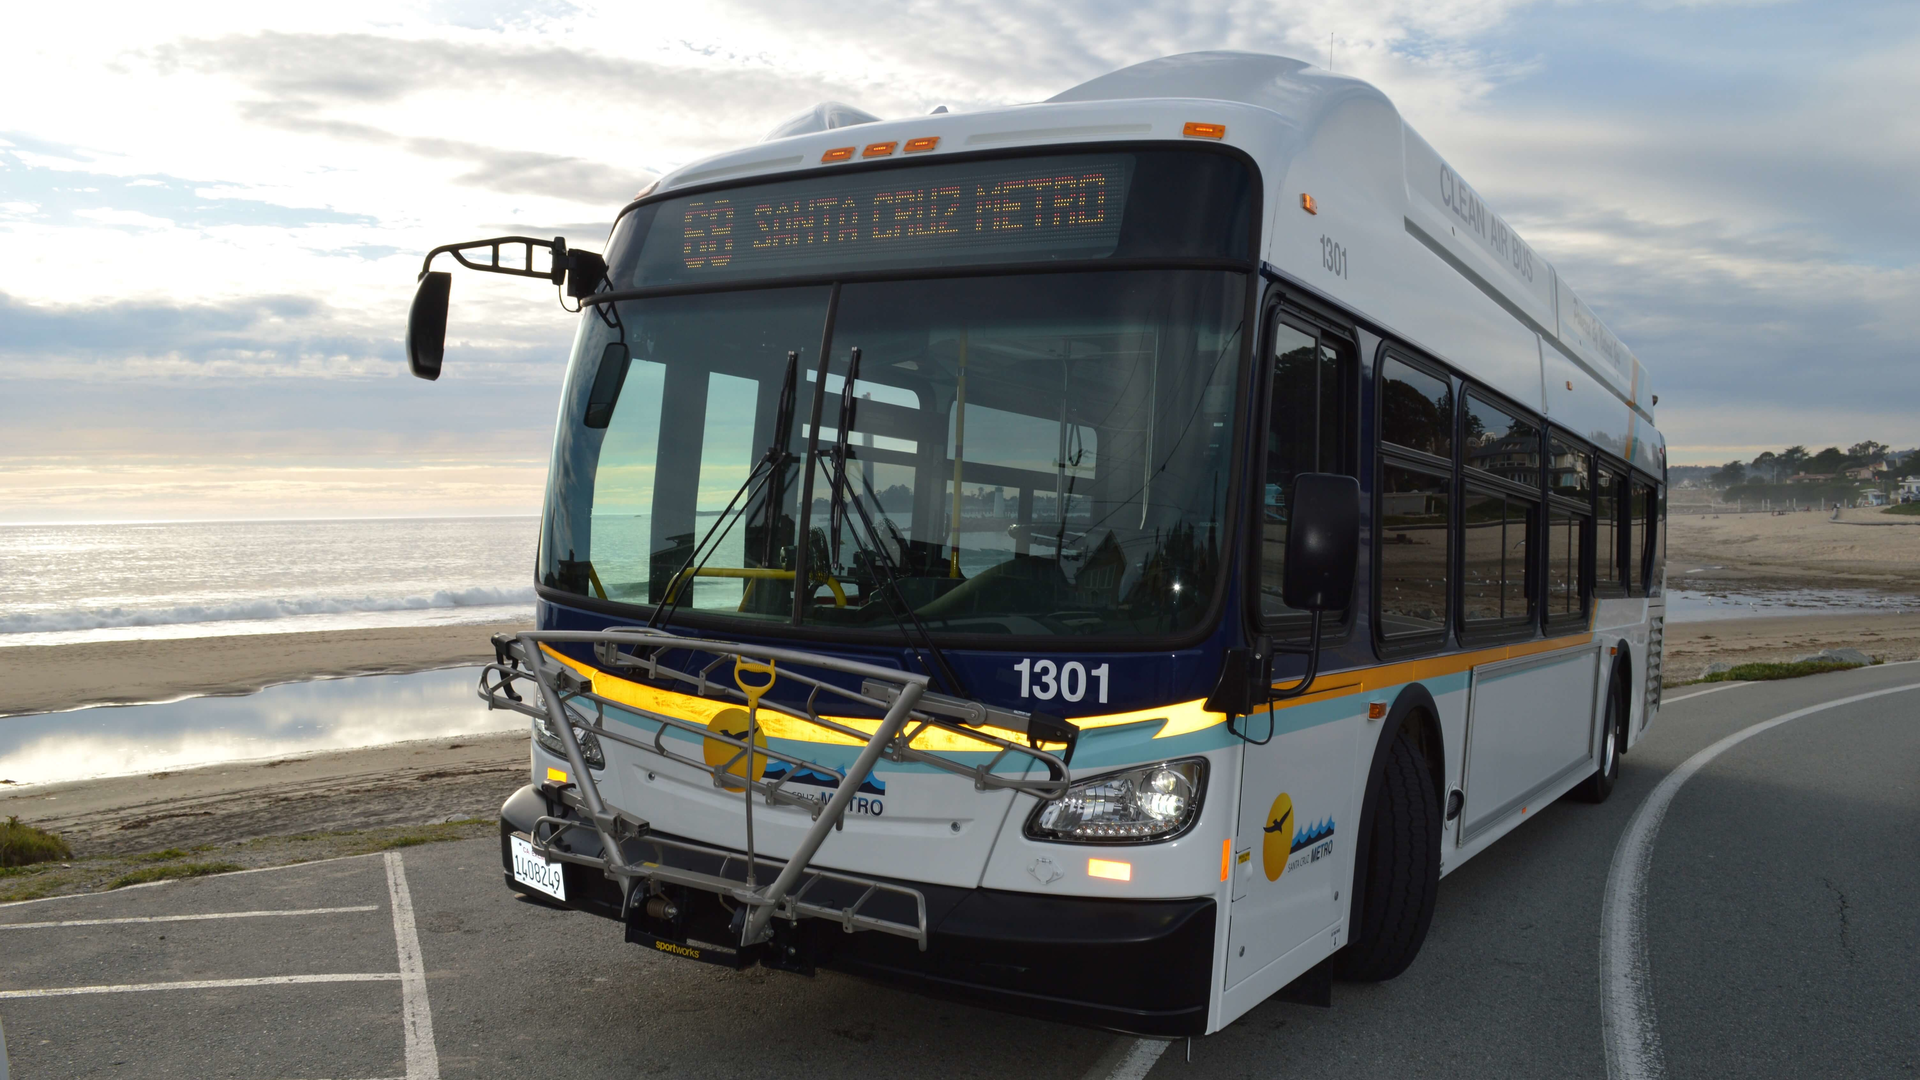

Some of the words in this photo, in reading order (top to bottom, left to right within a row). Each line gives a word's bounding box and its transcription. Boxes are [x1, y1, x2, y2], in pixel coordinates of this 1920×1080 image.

[753, 196, 858, 249] SANTA
[873, 186, 961, 239] CRUZ
[975, 173, 1105, 231] METRO
[1440, 162, 1486, 240] CLEAN
[1490, 212, 1509, 261] AIR
[1511, 232, 1533, 283] BUS
[1319, 233, 1348, 281] 1301
[1013, 658, 1109, 704] 1301
[821, 791, 884, 817] MTRO
[1310, 839, 1334, 864] METRO
[515, 854, 561, 891] 1408249
[655, 940, 700, 959] sportworks
